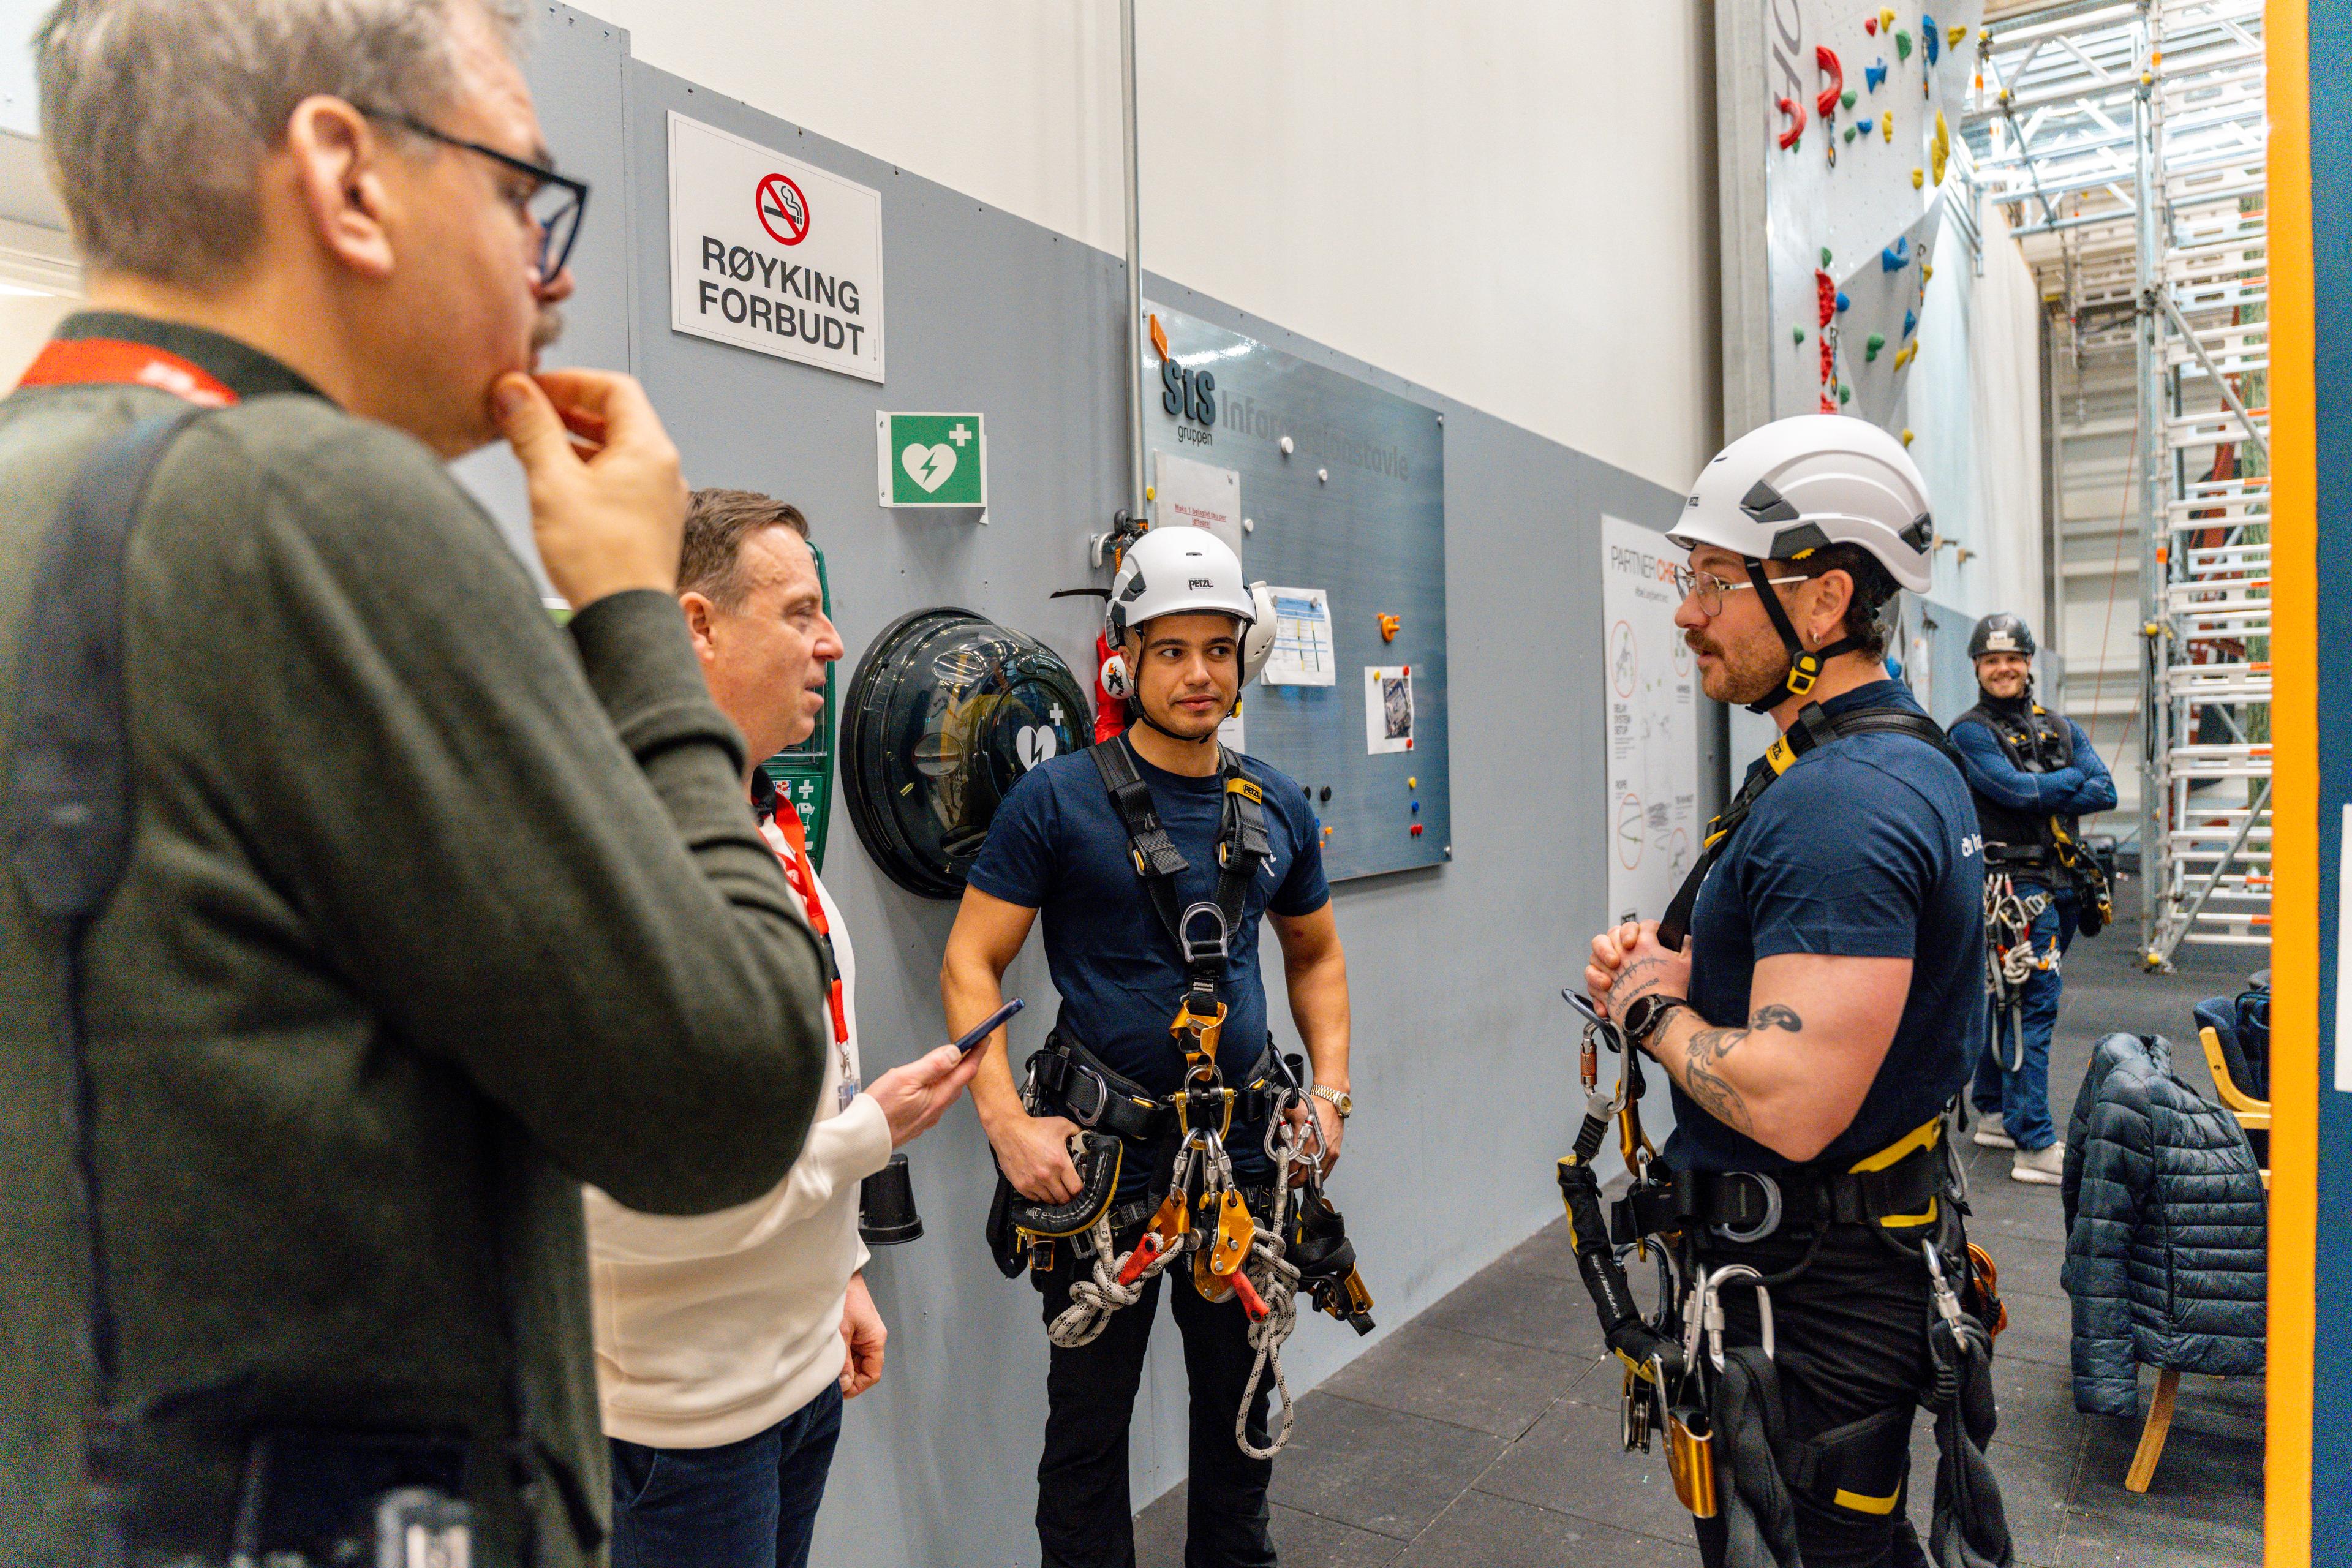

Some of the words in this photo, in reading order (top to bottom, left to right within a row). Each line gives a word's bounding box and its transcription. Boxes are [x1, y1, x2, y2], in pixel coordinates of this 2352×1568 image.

[702, 235, 860, 316] RØYKING
[699, 279, 865, 356] FORBUDT
[1178, 426, 1213, 447] gruppen
[1175, 503, 1187, 513] Maks
[1192, 508, 1210, 519] belastet
[1188, 579, 1214, 591] PETZL
[1244, 785, 1261, 799] PETZL
